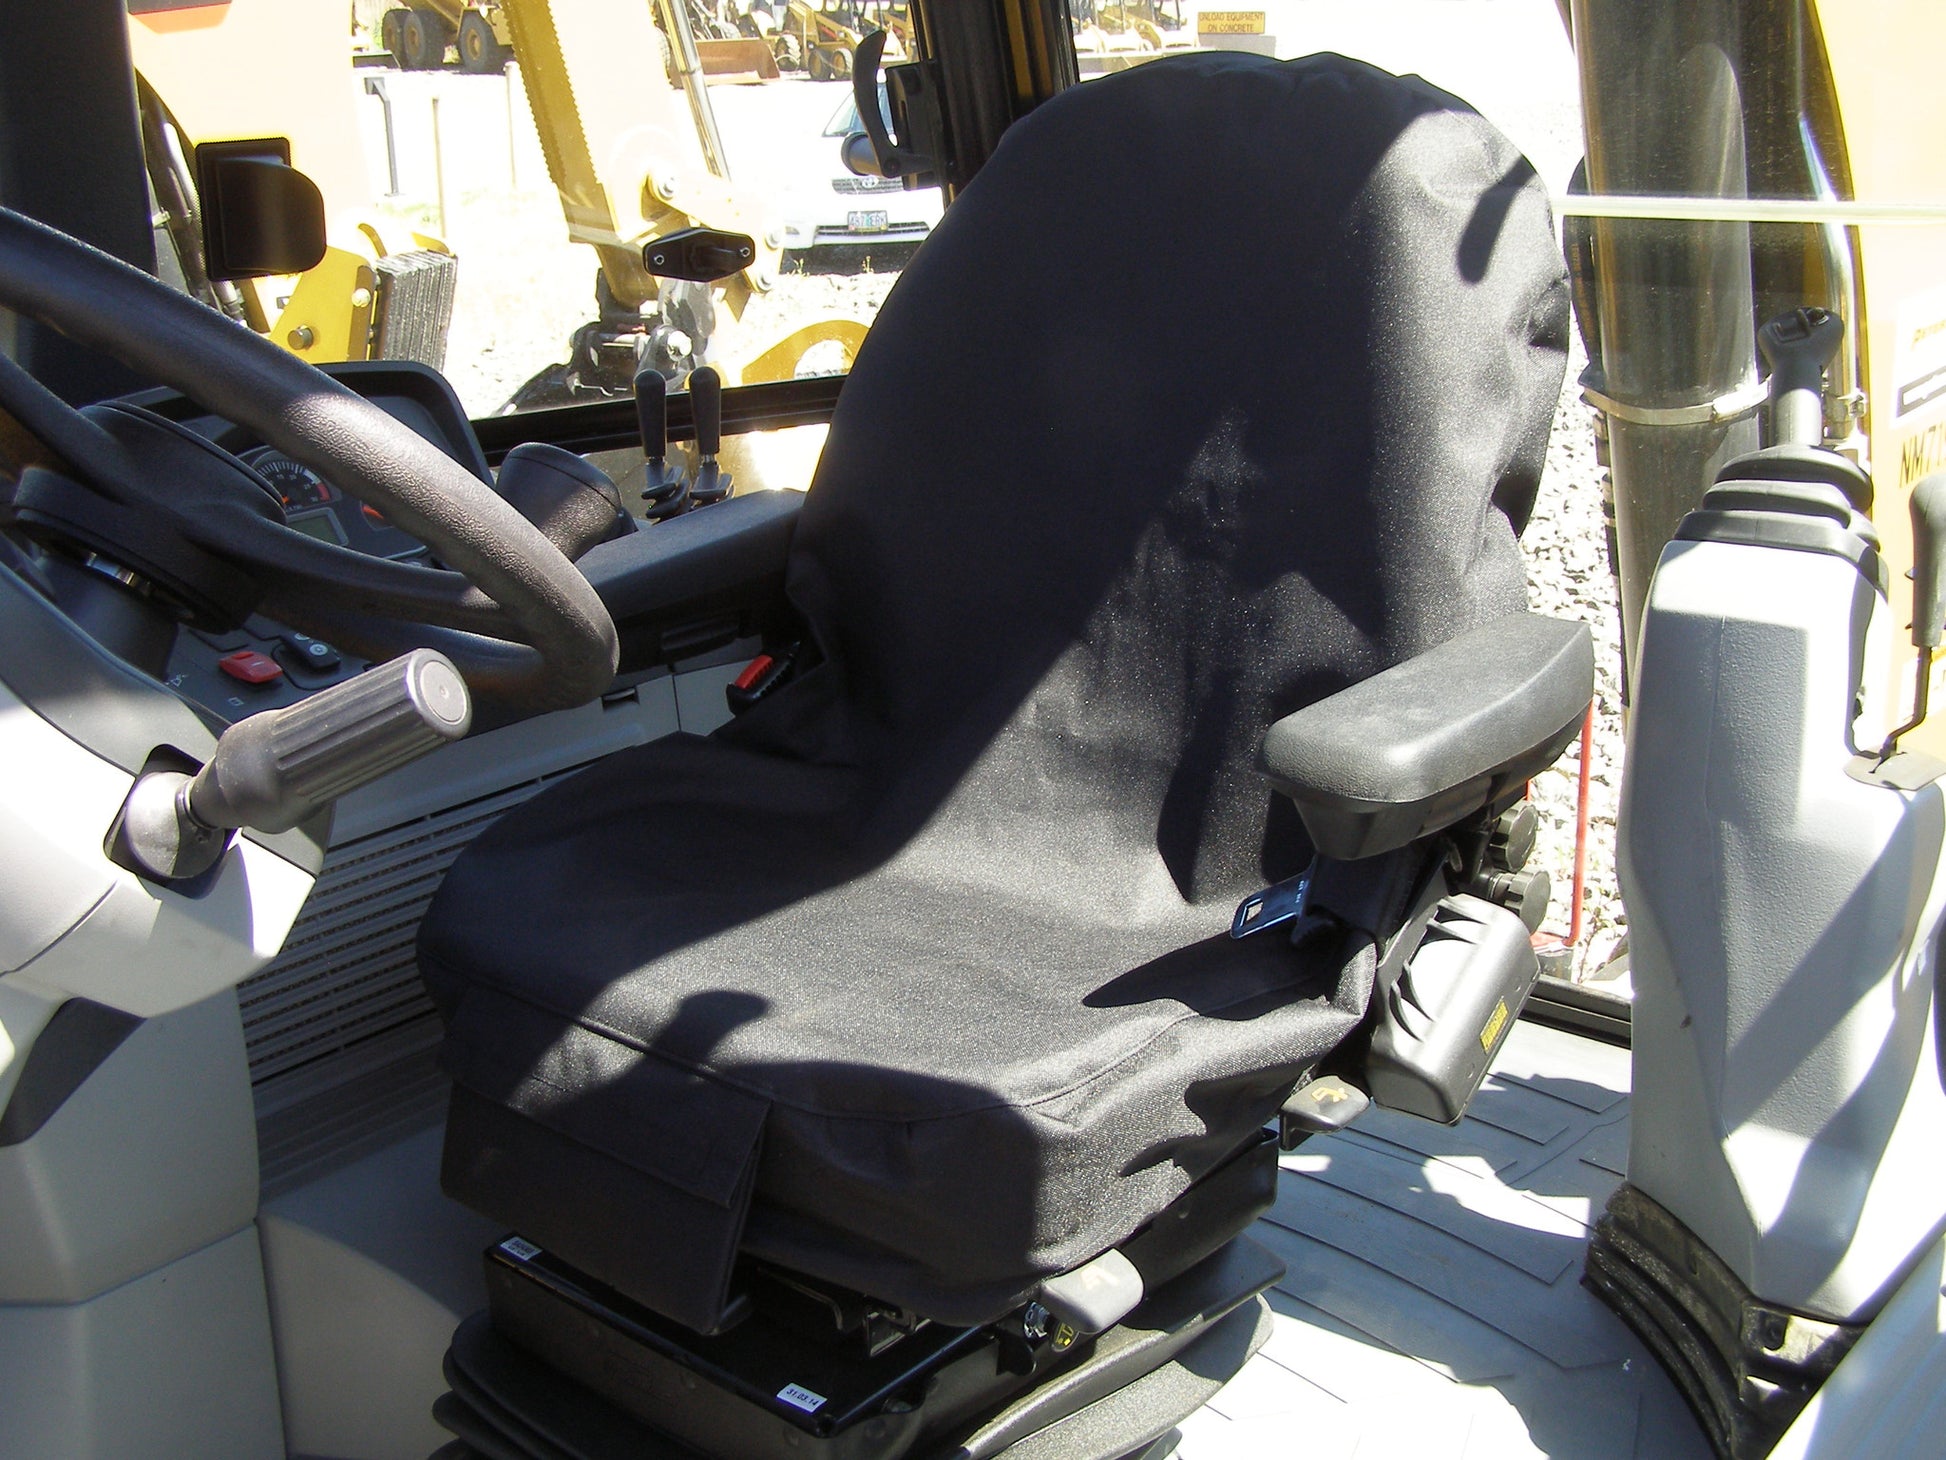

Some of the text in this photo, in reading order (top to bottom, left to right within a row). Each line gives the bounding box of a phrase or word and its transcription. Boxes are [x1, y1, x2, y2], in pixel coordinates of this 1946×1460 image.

[1200, 12, 1263, 21] UNLOAD EQUIPMENT
[1208, 24, 1254, 33] ON CONCRETE
[786, 1388, 820, 1406] 31.03.14
